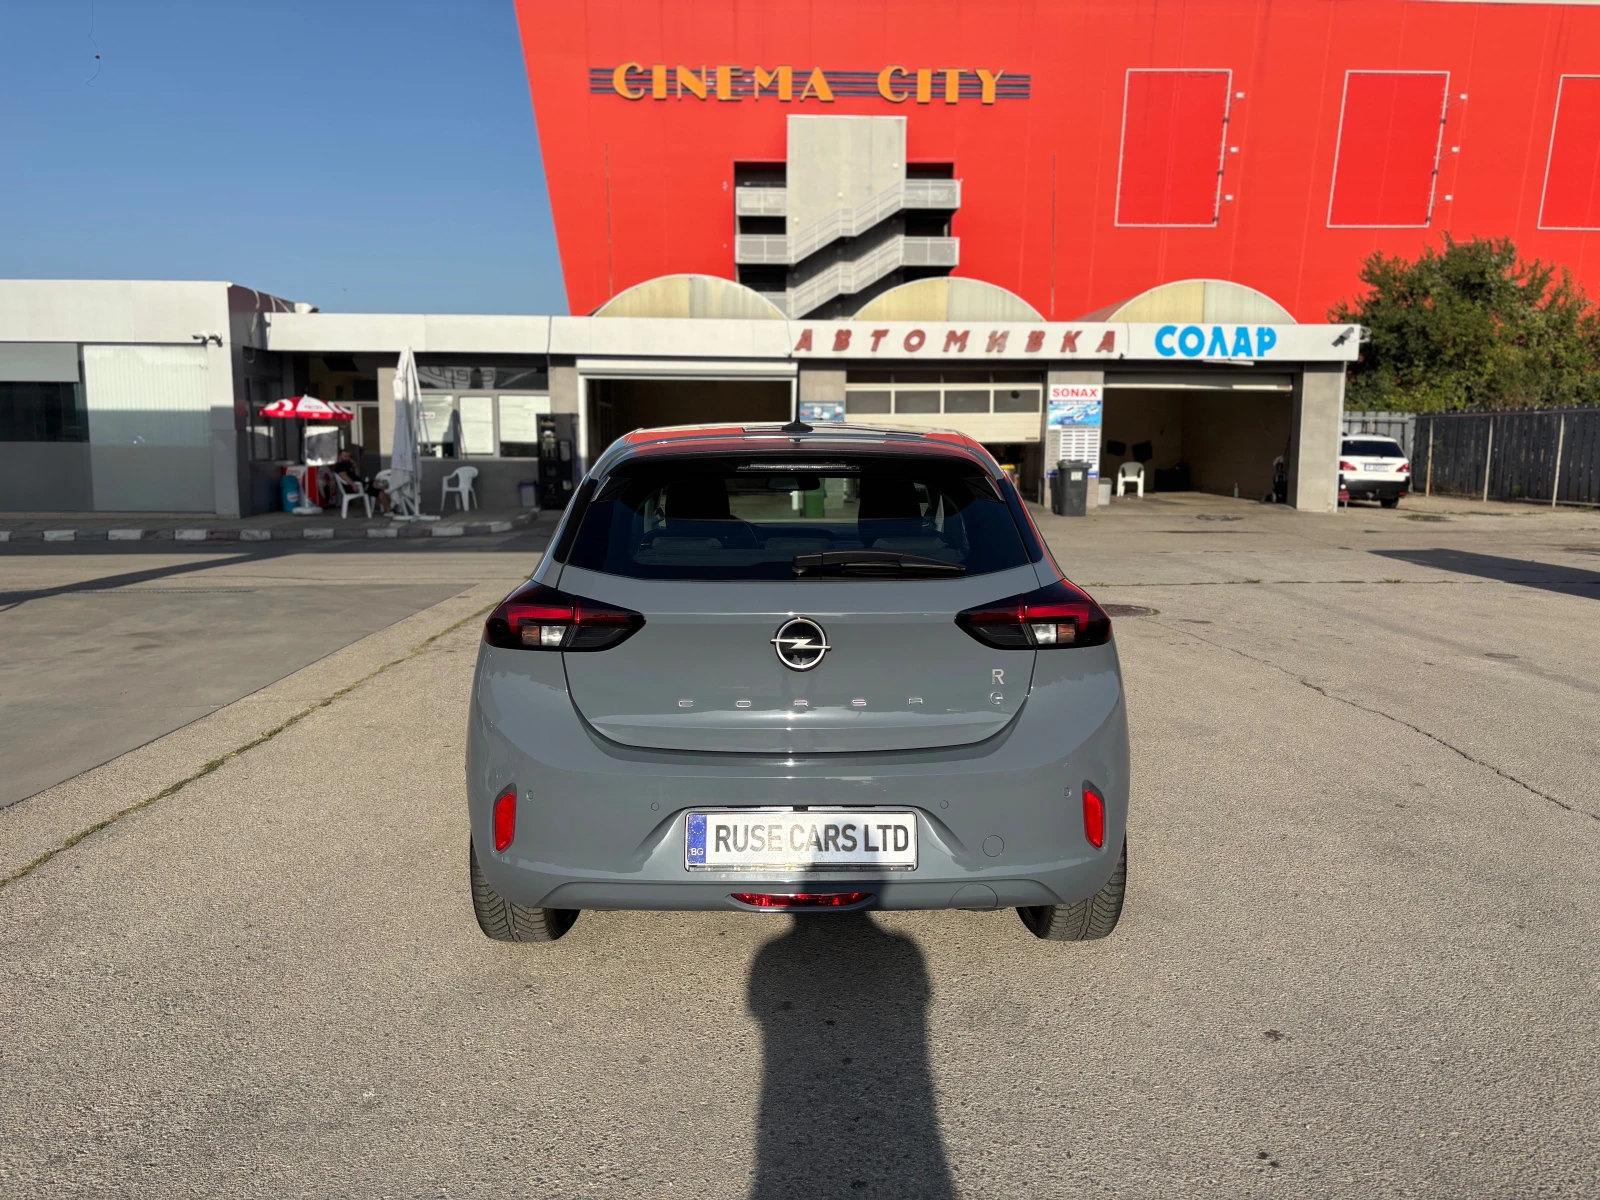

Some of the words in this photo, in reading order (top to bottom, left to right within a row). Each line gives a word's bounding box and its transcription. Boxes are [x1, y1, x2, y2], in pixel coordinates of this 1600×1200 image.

[612, 62, 835, 102] CINEMA
[877, 65, 1004, 105] CITY
[794, 328, 1116, 352] АВТОМИВКА
[1154, 325, 1277, 357] СОЛАР
[1052, 387, 1098, 398] SONAX
[678, 697, 923, 707] CORSA
[715, 824, 783, 853] RUSE
[789, 824, 858, 852] CARS
[864, 824, 909, 852] LTD
[691, 847, 704, 856] BG
